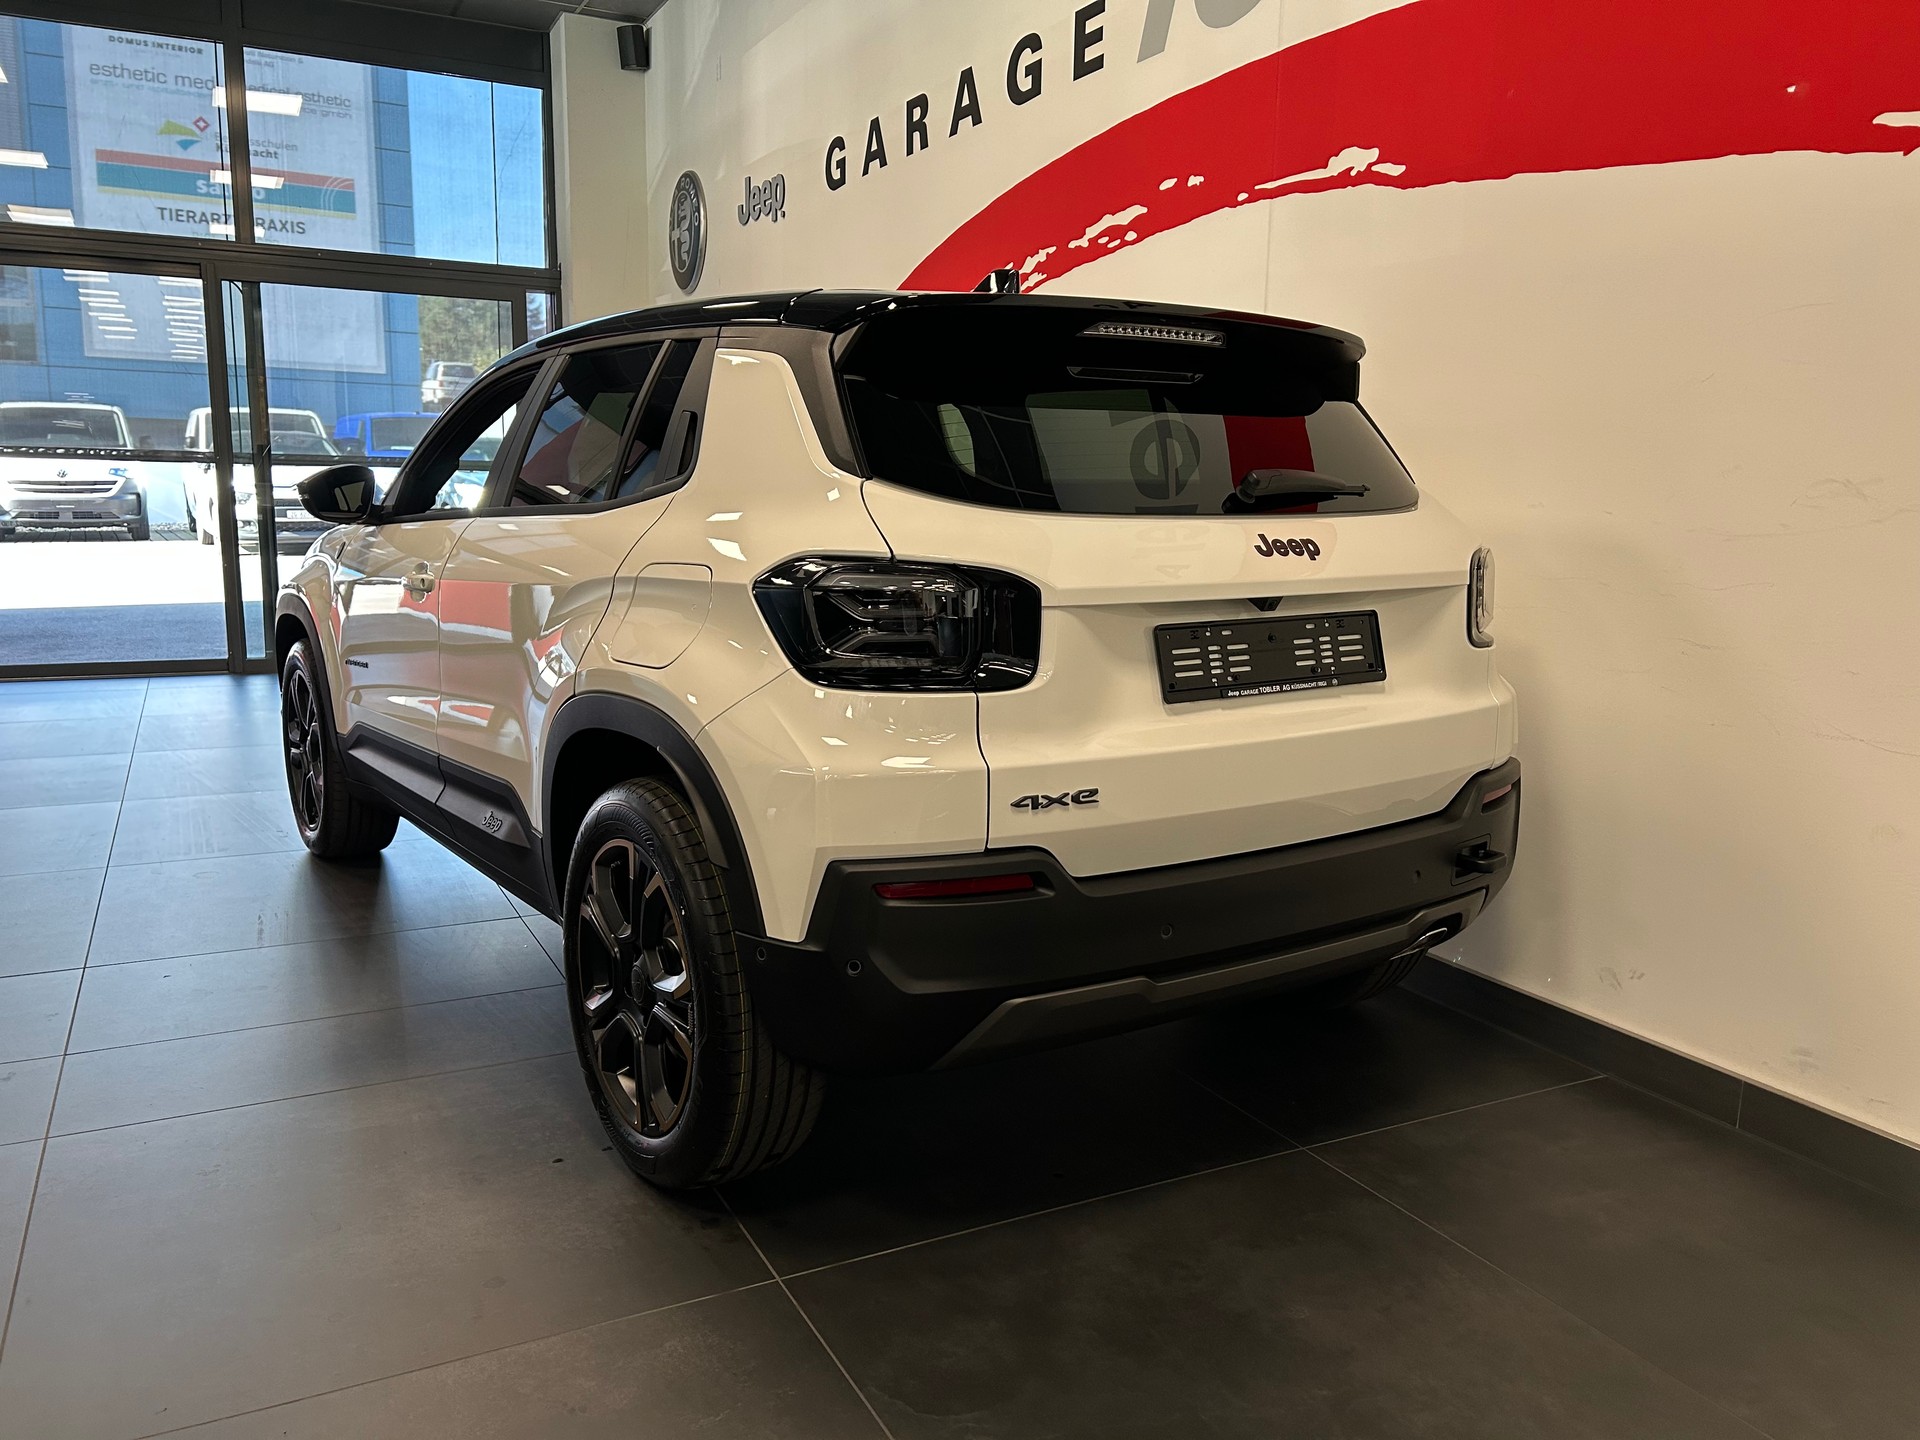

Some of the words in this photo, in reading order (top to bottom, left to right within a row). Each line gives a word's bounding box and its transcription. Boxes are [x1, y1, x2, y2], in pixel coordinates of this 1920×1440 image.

[108, 35, 149, 47] DOMUS
[152, 41, 204, 55] INTERIOR
[89, 62, 167, 84] esthetic
[825, 0, 1106, 191] GARAGE
[738, 173, 786, 226] Jeep
[1254, 533, 1320, 561] Jeep
[1259, 685, 1281, 693] TOBLER
[1010, 787, 1099, 810] 4xe
[481, 810, 503, 834] Jeep
